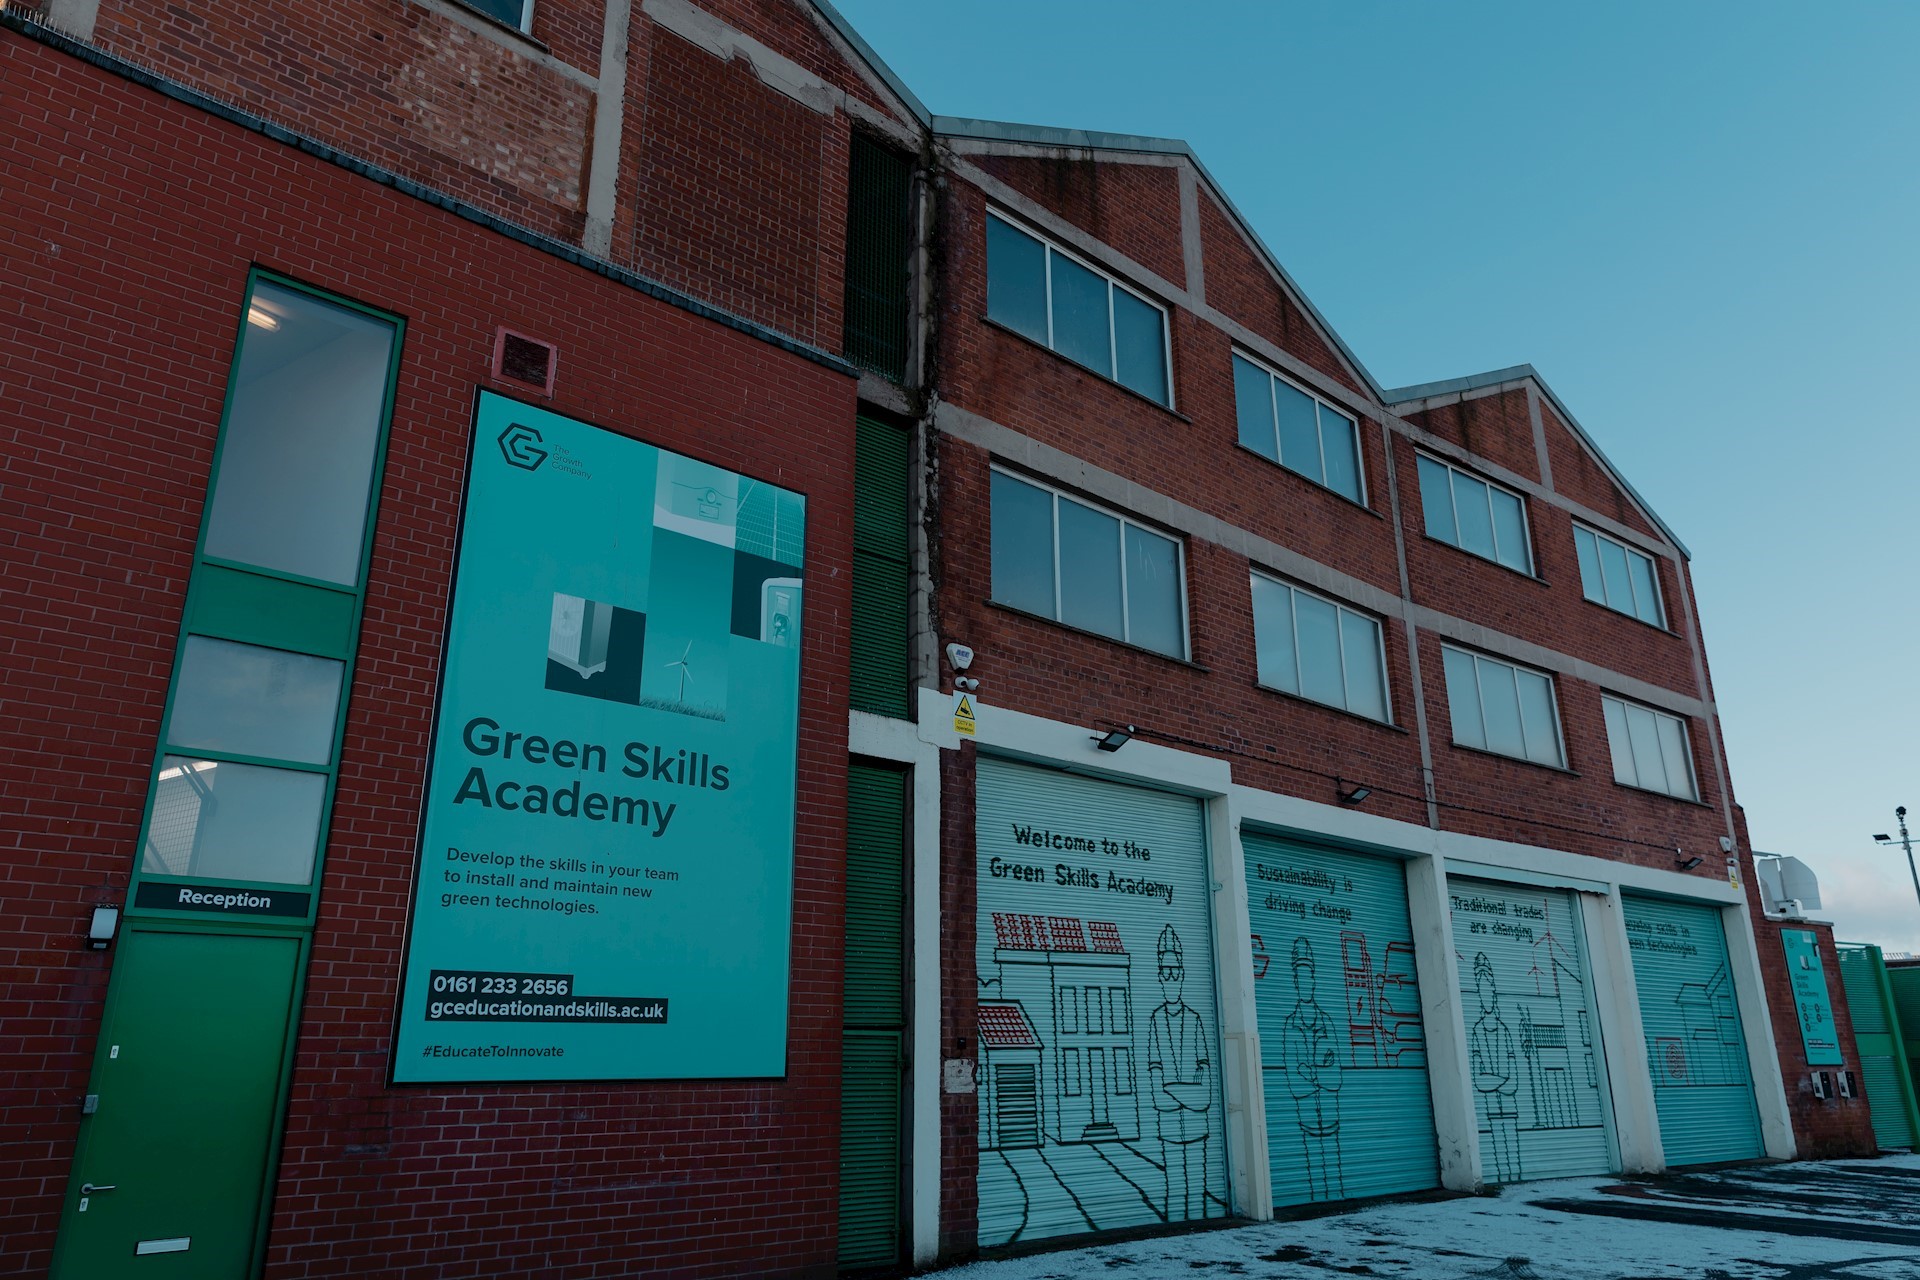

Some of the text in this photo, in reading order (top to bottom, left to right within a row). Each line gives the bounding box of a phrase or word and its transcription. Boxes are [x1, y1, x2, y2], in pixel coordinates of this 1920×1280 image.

[553, 453, 583, 467] Growth
[554, 444, 569, 455] The
[552, 462, 592, 480] Company
[463, 717, 730, 791] Green Skills
[453, 766, 677, 837] Academy
[1012, 823, 1151, 861] Welcome to the
[446, 847, 679, 881] Develop the skills in your team
[443, 869, 652, 898] to install and maintain new
[989, 857, 1174, 905] Green Skills Academy
[1257, 863, 1353, 894] Sustainability is
[178, 888, 271, 908] Reception
[441, 893, 599, 915] green technologies.
[1264, 891, 1352, 925] driving change
[1451, 896, 1545, 920] Traditional trades
[1470, 920, 1533, 943] are changing
[1625, 920, 1652, 936] evelop
[1629, 940, 1645, 950] een
[433, 975, 568, 996] 0161 233 2656
[430, 999, 664, 1020] gceducationandskills.ac.uk
[422, 1044, 565, 1059] #EducateToInnovate
